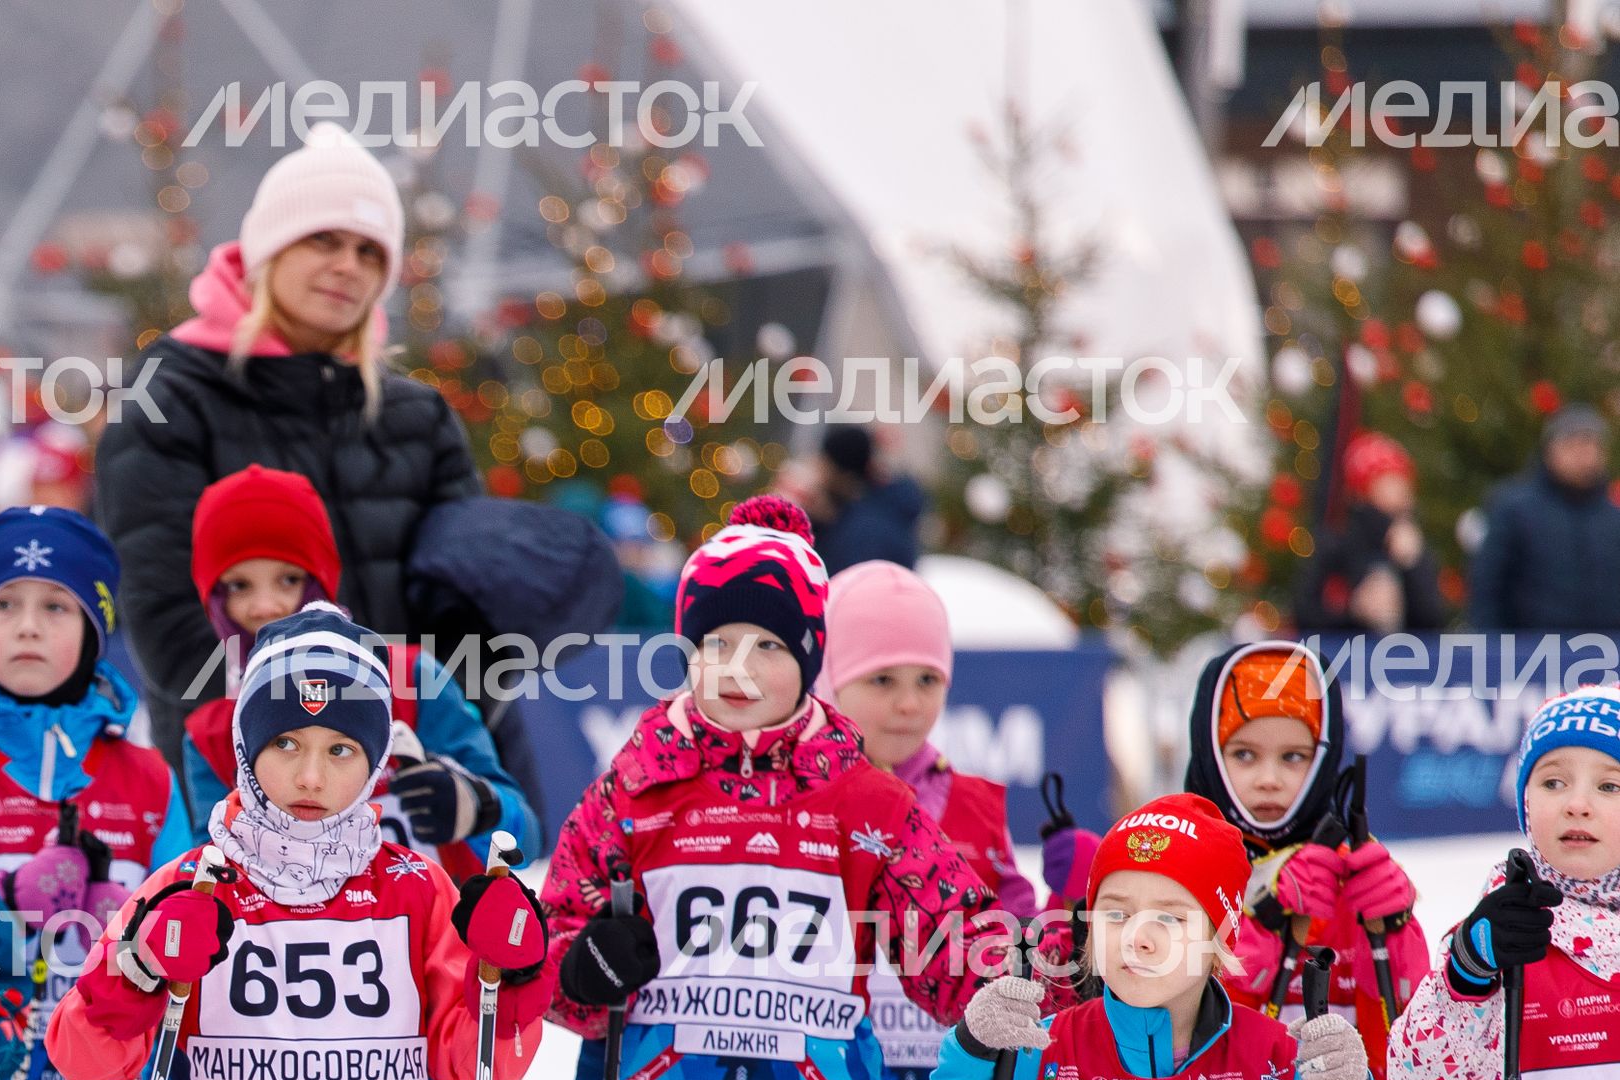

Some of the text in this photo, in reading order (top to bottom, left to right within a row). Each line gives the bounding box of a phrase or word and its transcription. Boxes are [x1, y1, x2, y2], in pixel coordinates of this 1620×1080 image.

[1117, 812, 1198, 840] LUKOIL
[676, 886, 832, 965] 667
[230, 939, 390, 1019] 653
[1576, 995, 1611, 1007] ПАРКИ
[703, 1031, 779, 1055] ЛЫЖНЯ
[1549, 1030, 1608, 1045] УРАЛХИМ
